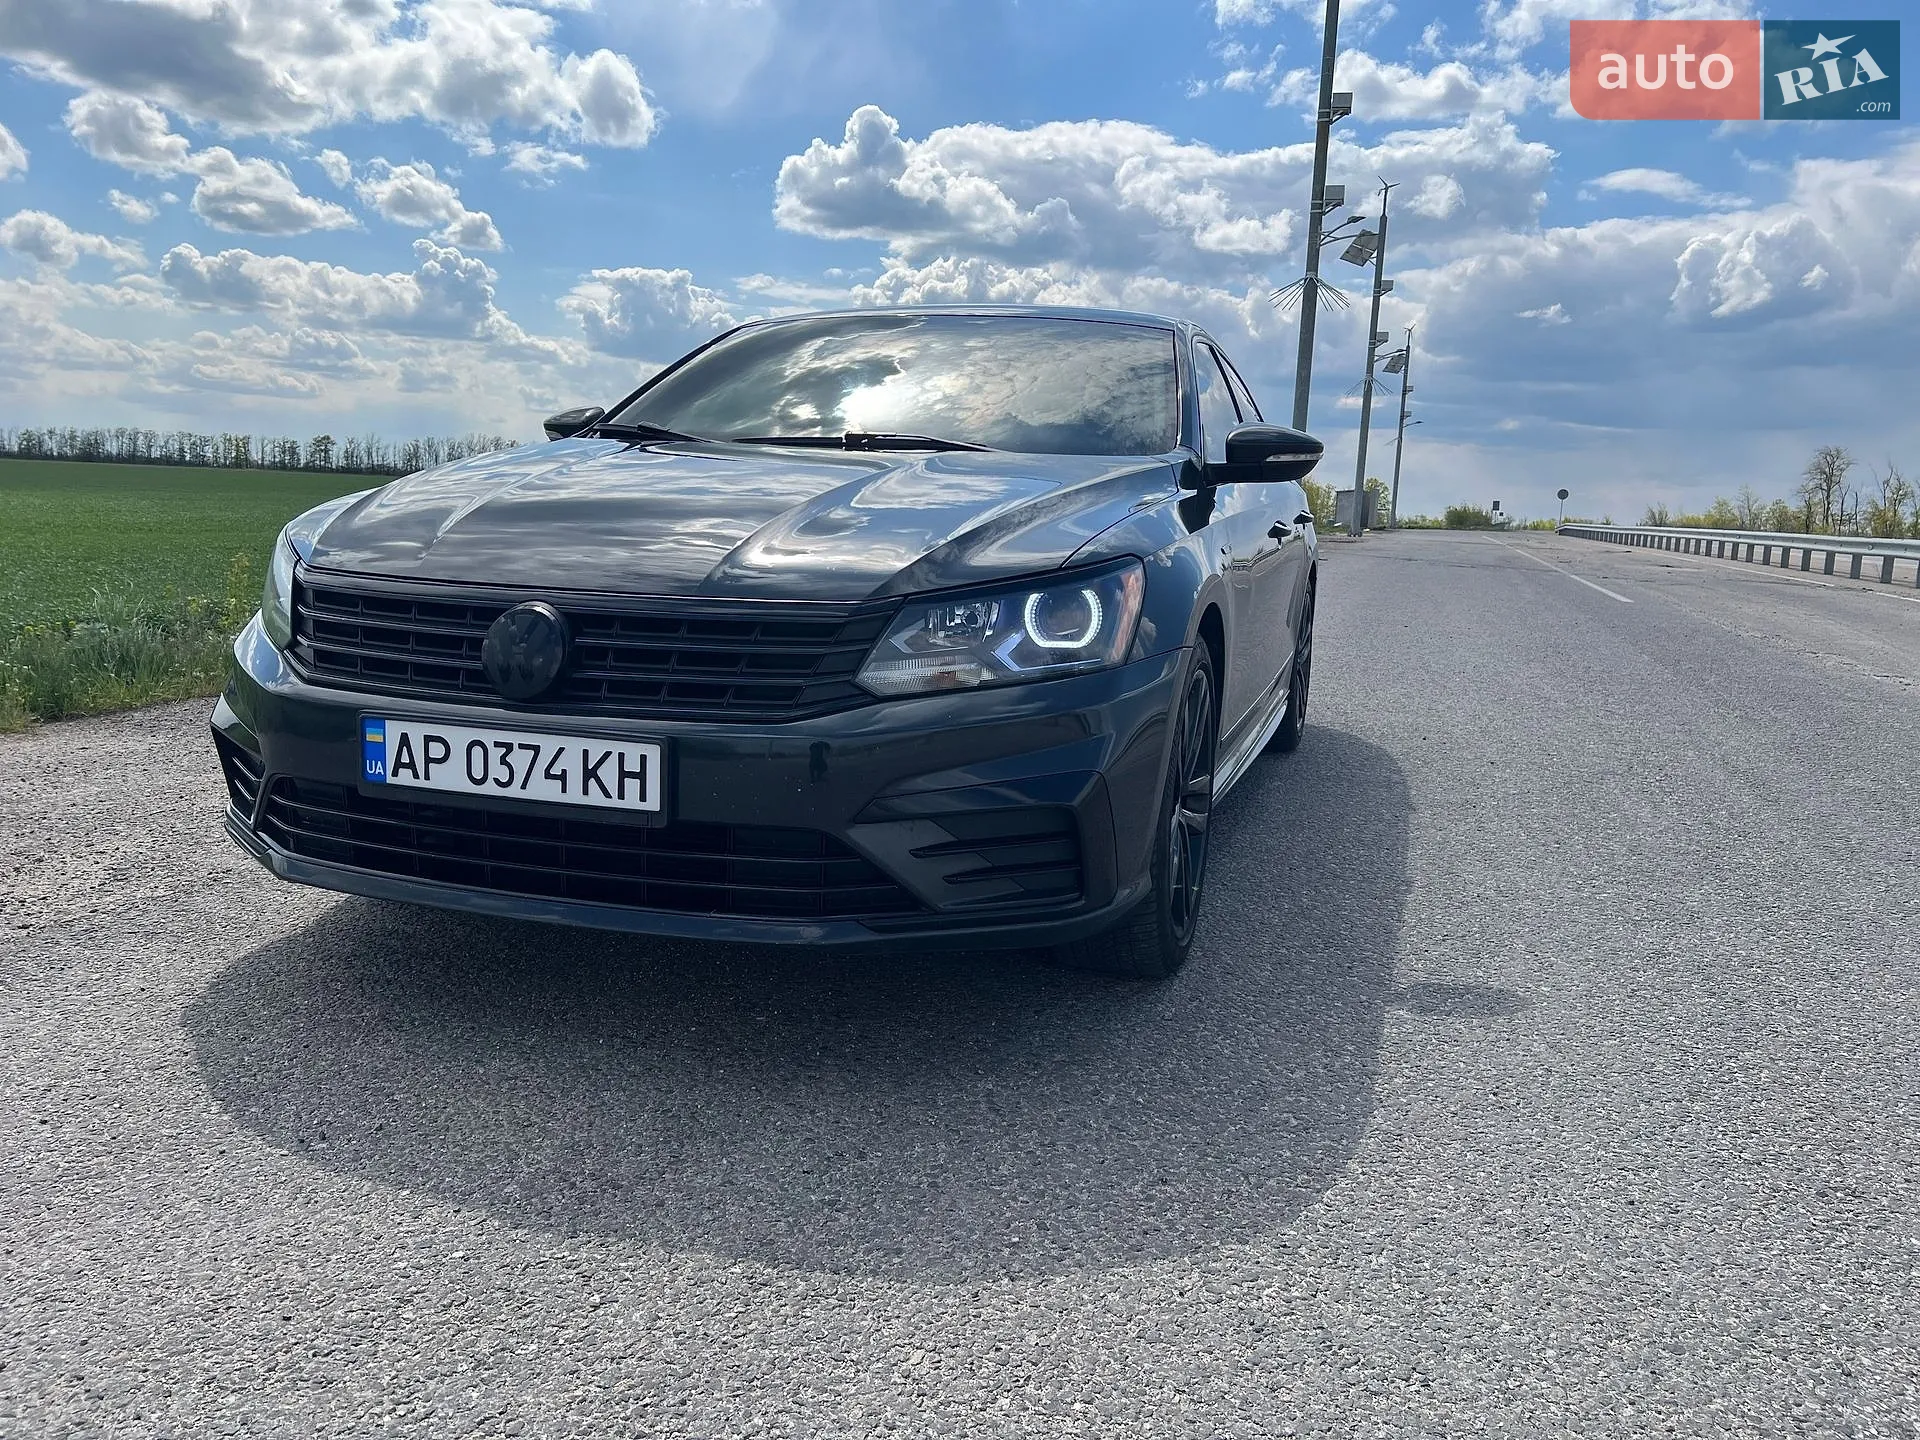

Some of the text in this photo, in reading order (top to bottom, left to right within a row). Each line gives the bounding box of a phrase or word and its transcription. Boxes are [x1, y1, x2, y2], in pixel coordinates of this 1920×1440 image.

[366, 760, 384, 775] UA
[391, 732, 648, 803] AP 0374 KH
